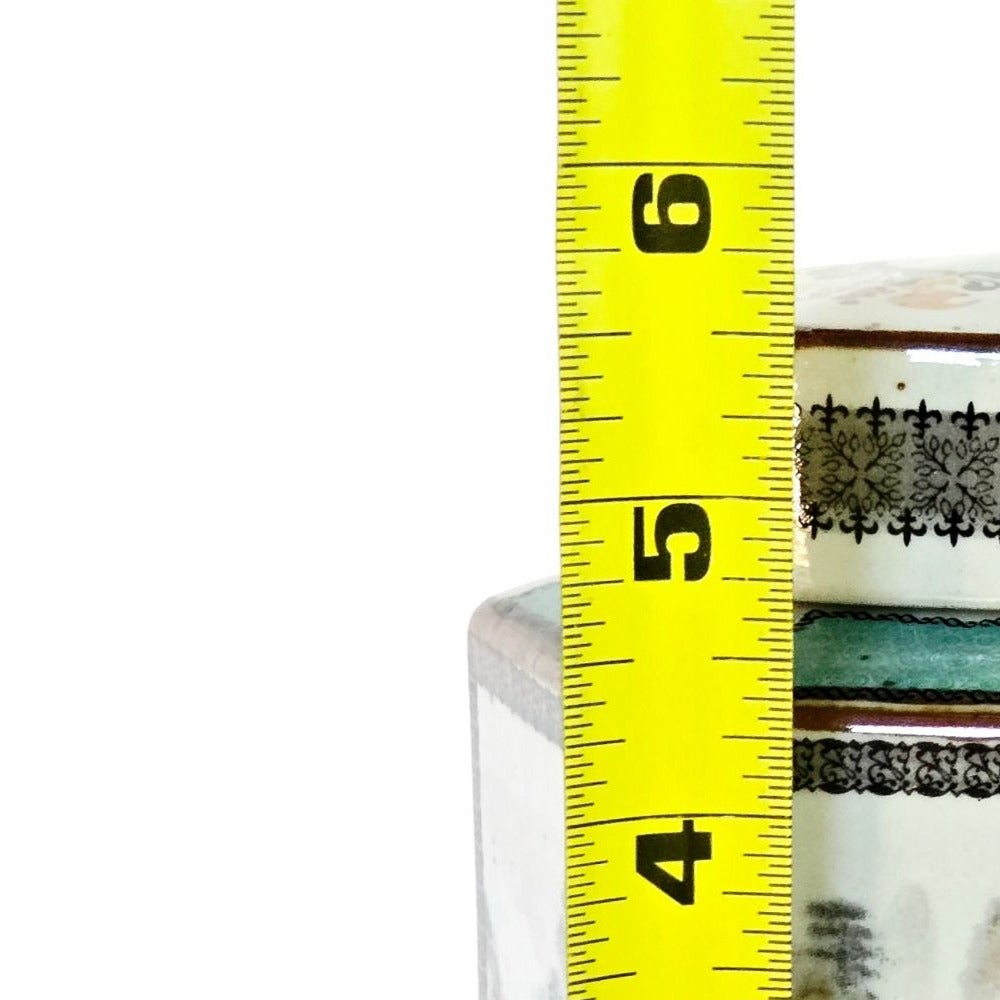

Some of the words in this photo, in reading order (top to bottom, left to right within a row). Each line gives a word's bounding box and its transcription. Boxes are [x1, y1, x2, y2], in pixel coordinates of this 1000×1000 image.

[632, 173, 712, 254] 6
[633, 502, 712, 582] 5
[635, 819, 712, 906] 4
